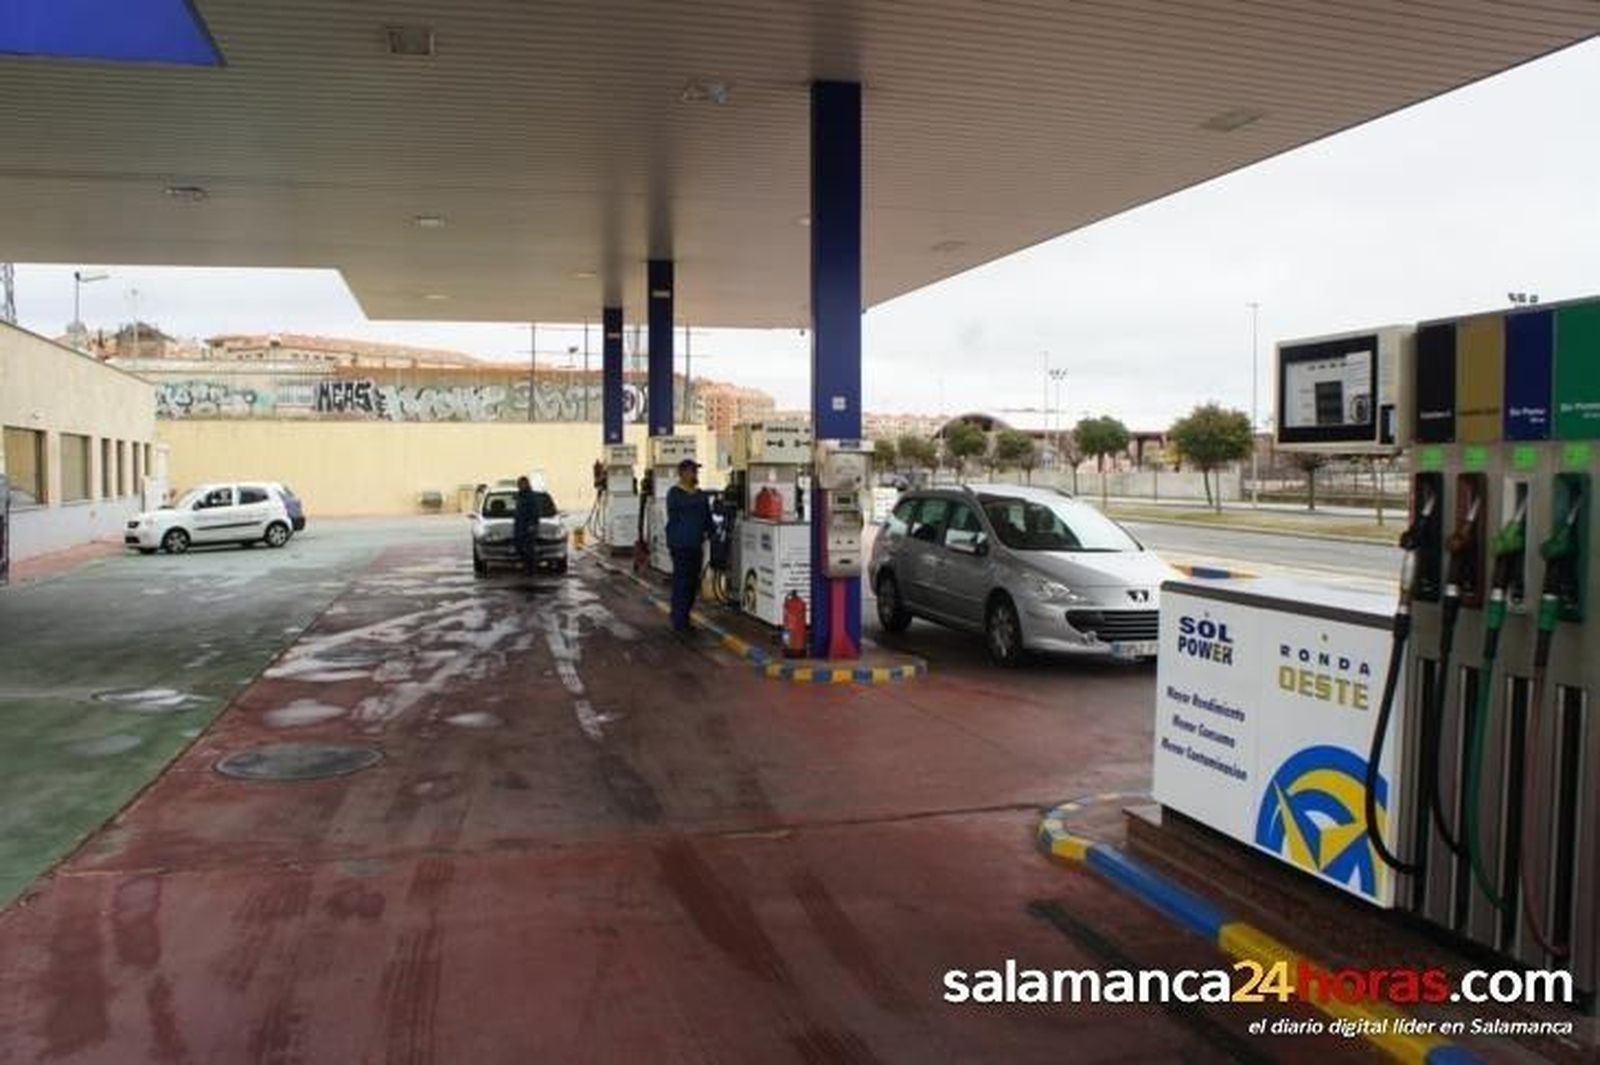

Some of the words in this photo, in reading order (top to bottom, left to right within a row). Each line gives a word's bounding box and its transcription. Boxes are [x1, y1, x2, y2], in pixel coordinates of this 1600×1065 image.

[1179, 616, 1233, 643] SOL
[1177, 635, 1233, 666] POWER
[1280, 645, 1370, 676] RONDA
[1278, 665, 1369, 710] OESTE
